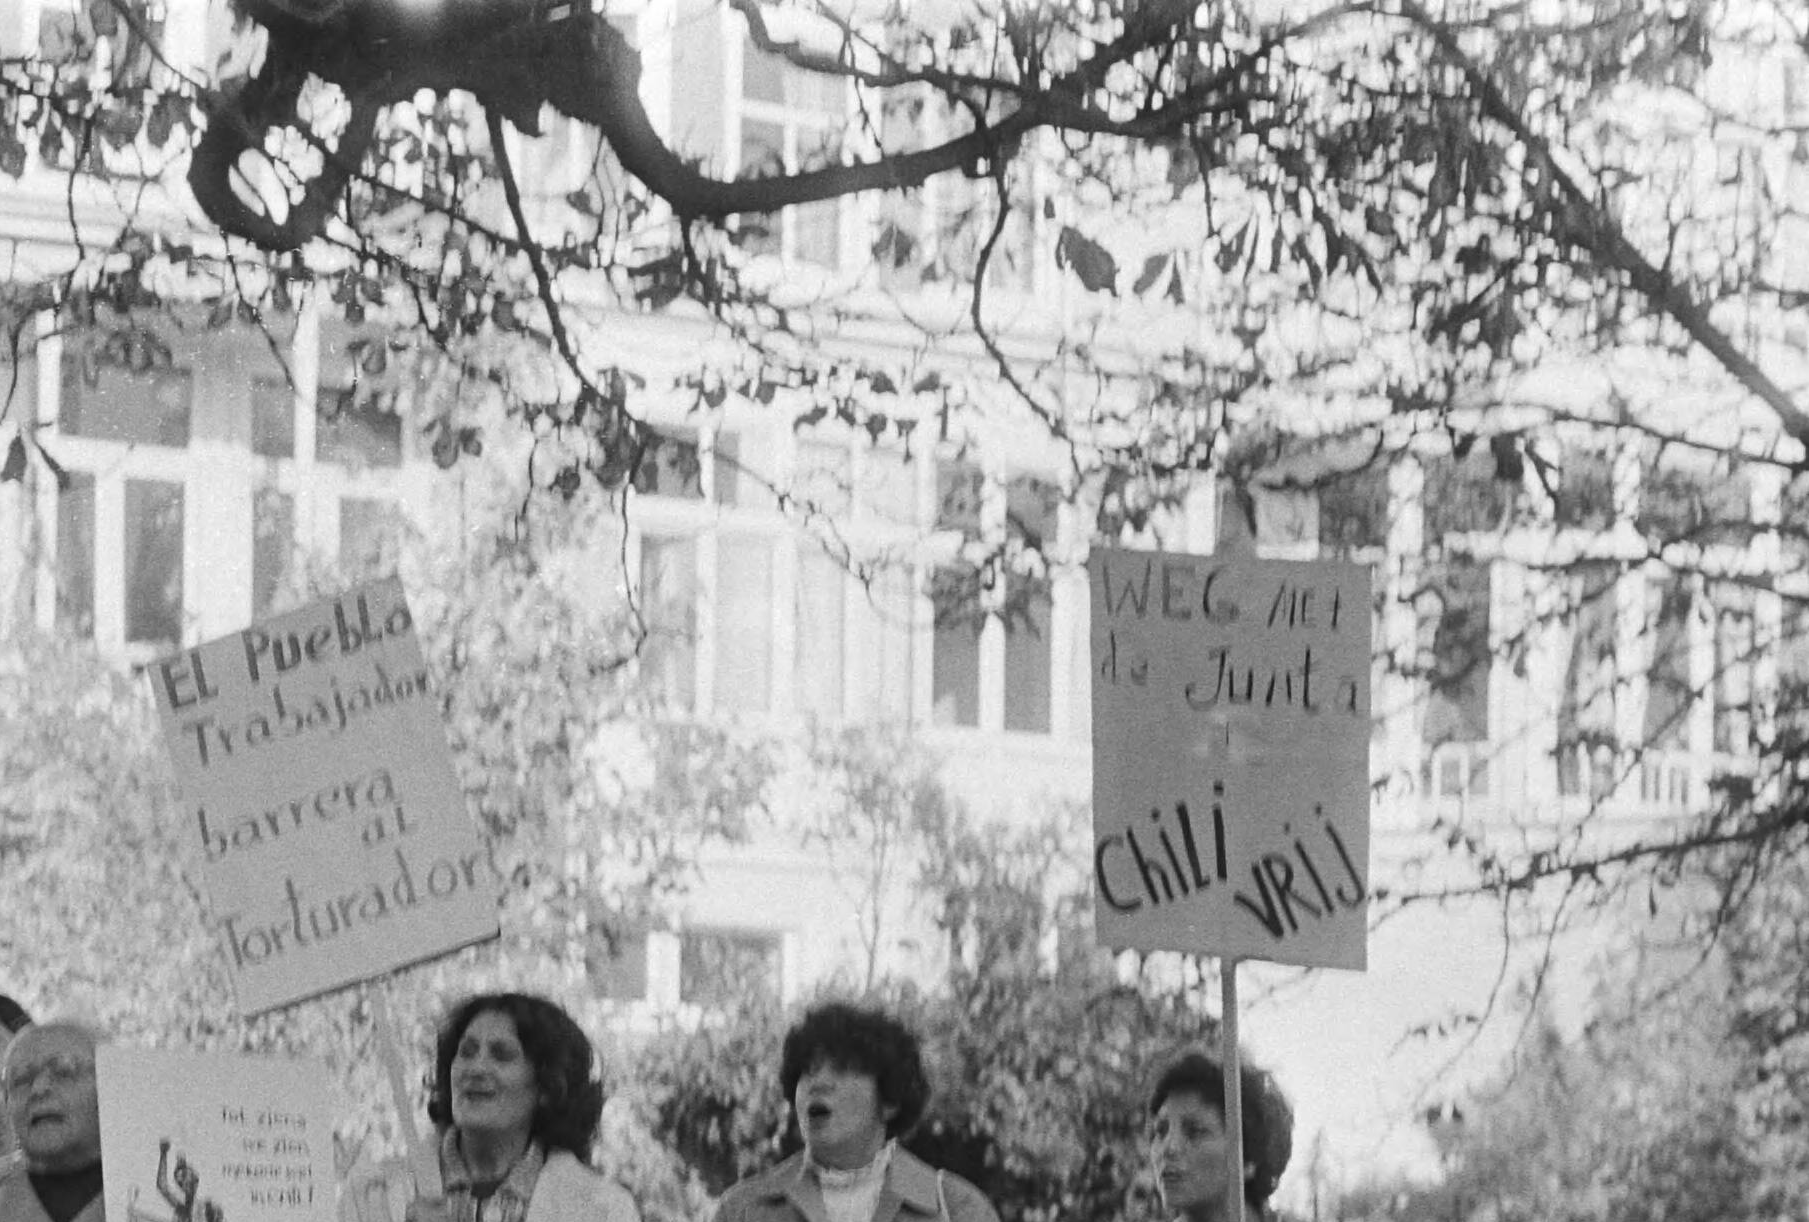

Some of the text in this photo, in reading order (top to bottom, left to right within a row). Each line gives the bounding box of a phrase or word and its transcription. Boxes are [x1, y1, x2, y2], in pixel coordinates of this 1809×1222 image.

[1101, 558, 1239, 625] WEG
[160, 649, 219, 710] EL
[1184, 643, 1358, 717] Junta
[197, 769, 394, 863] barrera
[217, 847, 481, 968] Torturador
